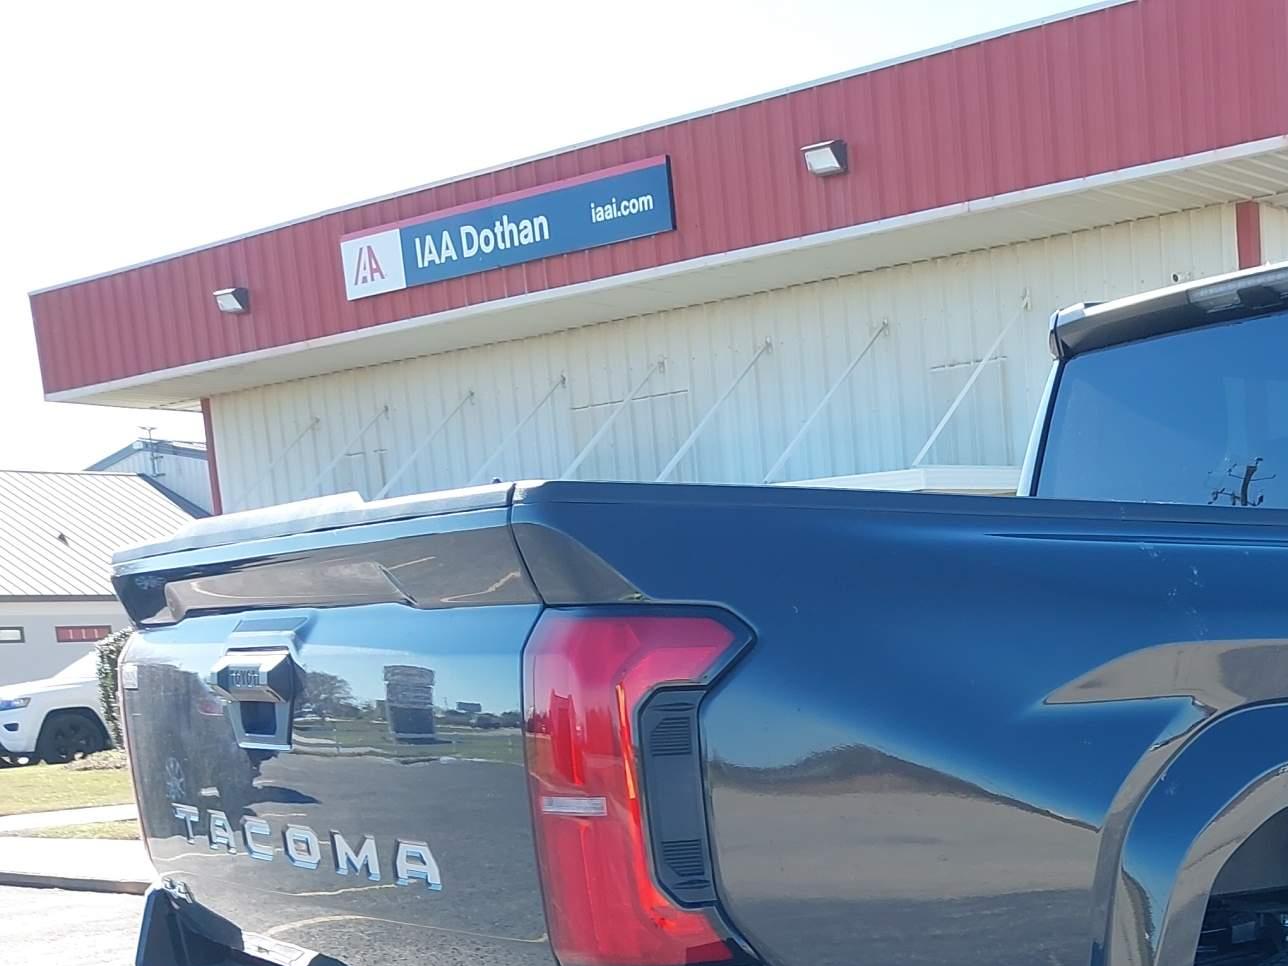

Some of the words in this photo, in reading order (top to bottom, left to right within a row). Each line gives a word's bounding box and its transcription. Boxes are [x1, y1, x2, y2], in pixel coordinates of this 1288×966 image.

[590, 194, 655, 223] iaai.com
[414, 230, 458, 269] IAA
[460, 214, 550, 258] Dothan
[172, 802, 443, 891] TACOMA
